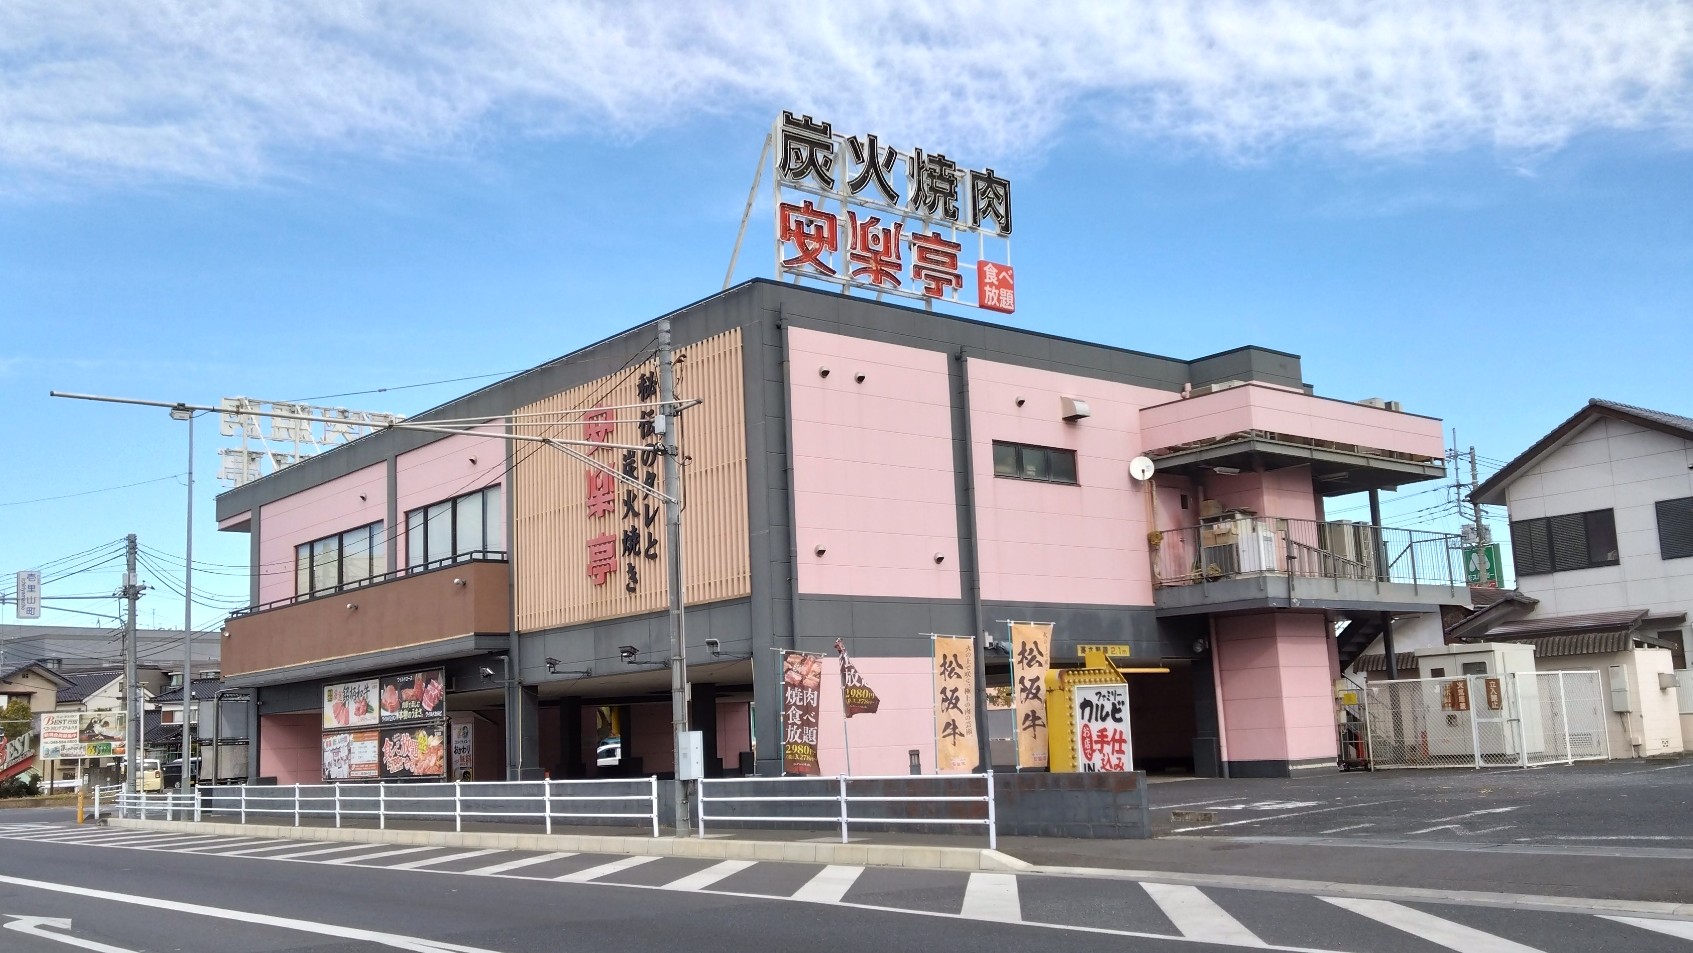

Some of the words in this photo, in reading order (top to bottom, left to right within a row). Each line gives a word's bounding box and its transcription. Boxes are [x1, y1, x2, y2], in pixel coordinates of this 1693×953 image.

[776, 110, 1012, 235] 炭火焼肉
[778, 200, 963, 298] 安楽亭
[984, 263, 1014, 285] 食べ
[984, 285, 1015, 311] 放題
[583, 403, 618, 586] 安楽亭
[620, 450, 642, 593] 炭火焼き
[786, 686, 818, 707] 焼肉
[939, 653, 966, 747] 松阪牛
[1017, 640, 1047, 740] 松阪牛
[1095, 690, 1122, 702] ファミリー
[1488, 681, 1500, 709] 立入禁止
[786, 706, 816, 725] 食べ
[1079, 698, 1126, 723] カルビ
[785, 725, 818, 745] 放題
